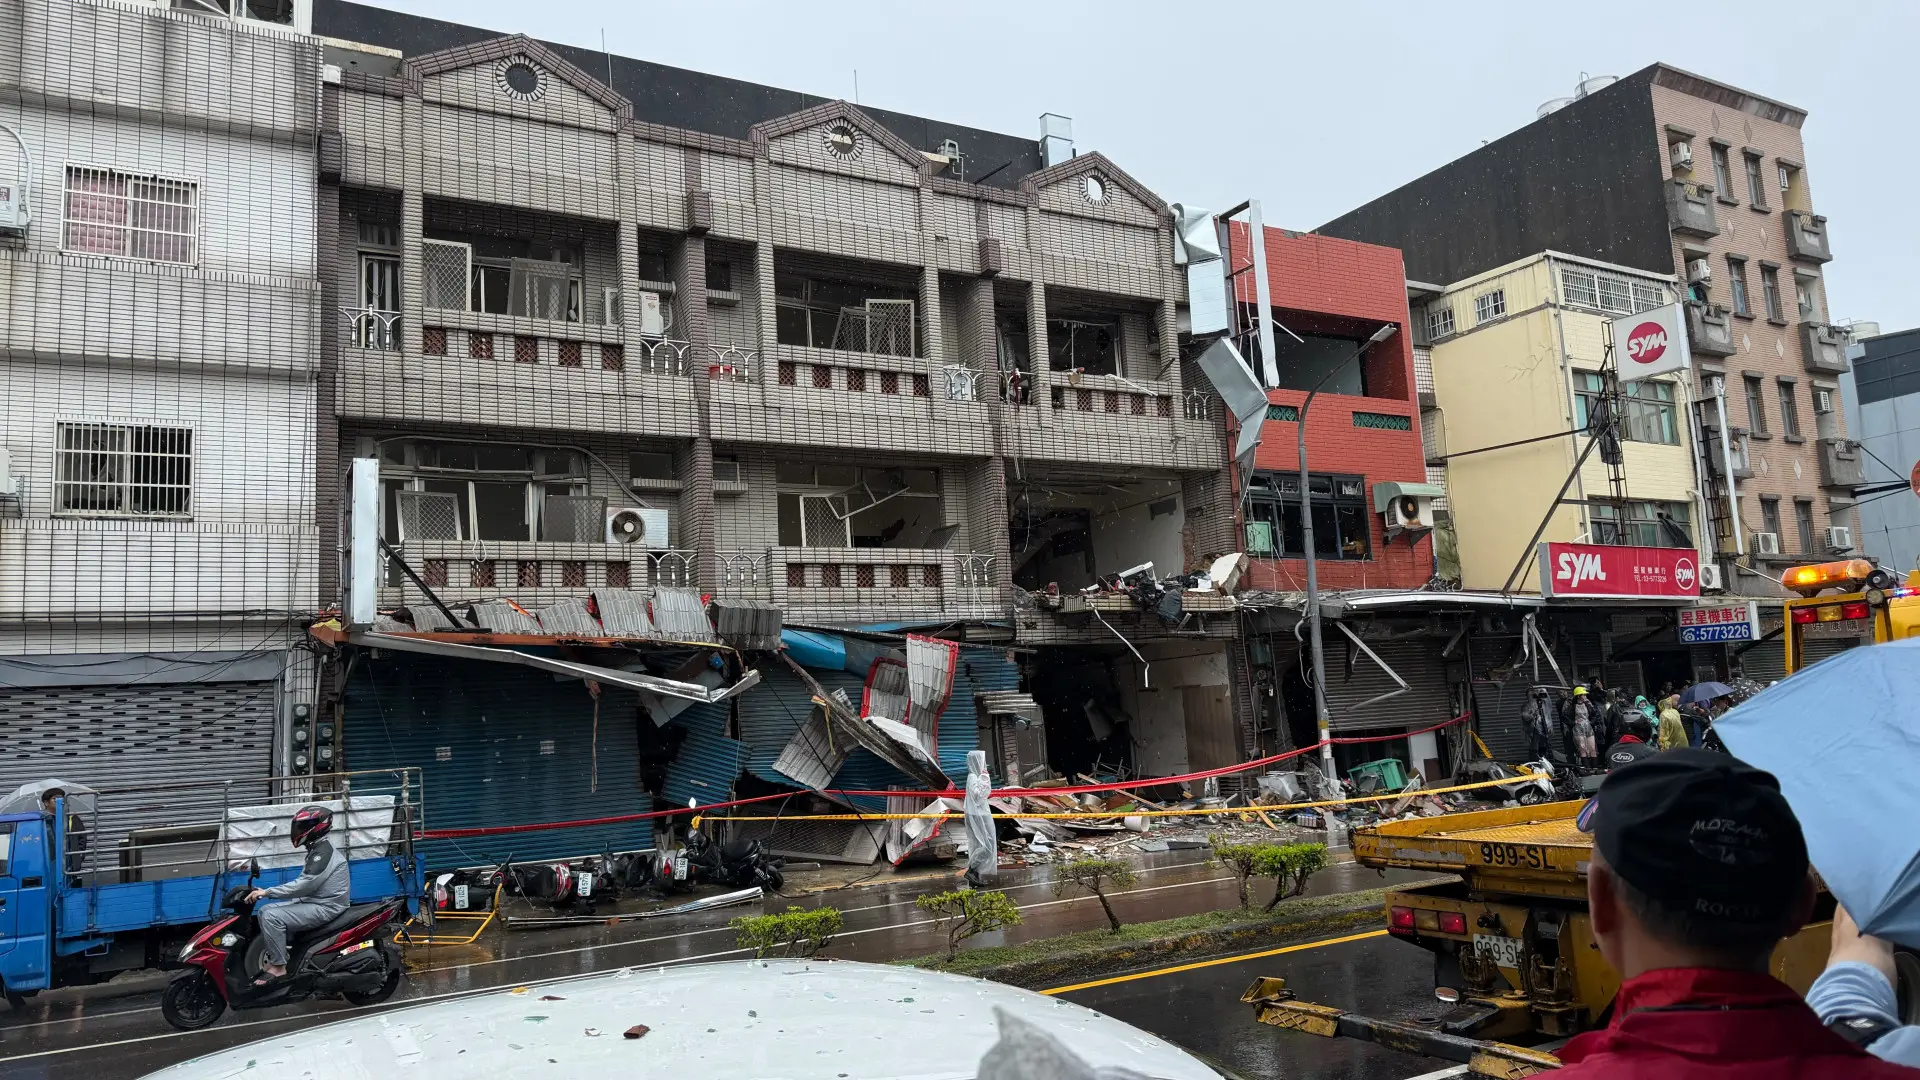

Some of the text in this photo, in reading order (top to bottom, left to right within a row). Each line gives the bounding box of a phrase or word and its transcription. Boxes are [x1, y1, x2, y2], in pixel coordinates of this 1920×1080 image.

[1628, 331, 1667, 357] SYM
[1557, 552, 1606, 588] SYM
[1681, 607, 1747, 626] 昱星機車行
[1480, 843, 1556, 869] 999-SL
